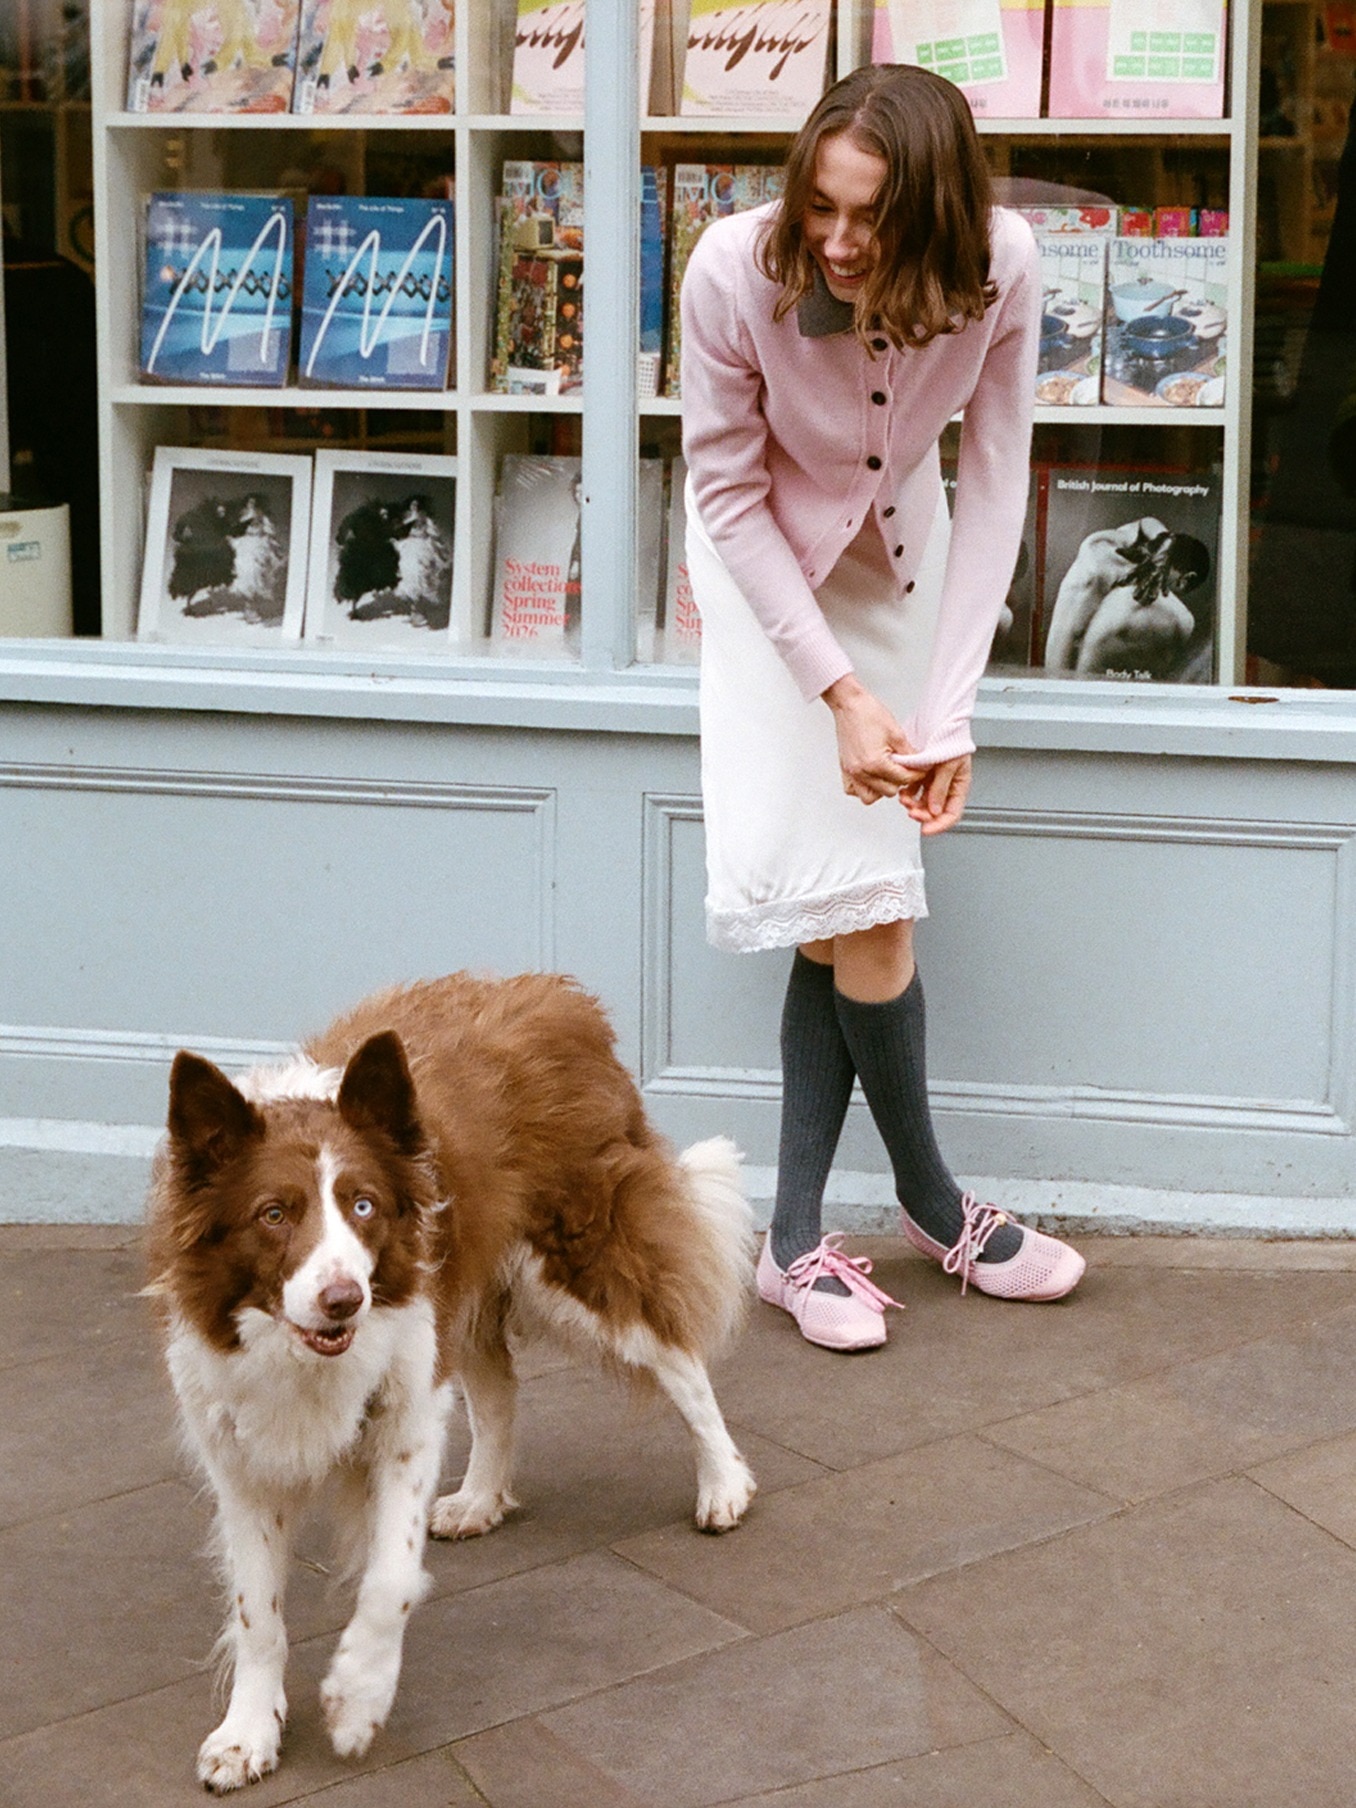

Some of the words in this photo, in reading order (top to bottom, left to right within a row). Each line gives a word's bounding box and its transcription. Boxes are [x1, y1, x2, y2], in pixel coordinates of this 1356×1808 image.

[1036, 239, 1099, 260] hsome
[1113, 239, 1227, 260] Toothsome
[1057, 478, 1090, 491] British
[1090, 480, 1128, 494] Journal
[1129, 482, 1141, 492] of
[1142, 482, 1209, 497] Photography
[504, 558, 560, 578] System
[503, 576, 582, 594] collection
[502, 593, 557, 612] Spring
[501, 609, 572, 626] Summer
[1105, 667, 1133, 681] Body
